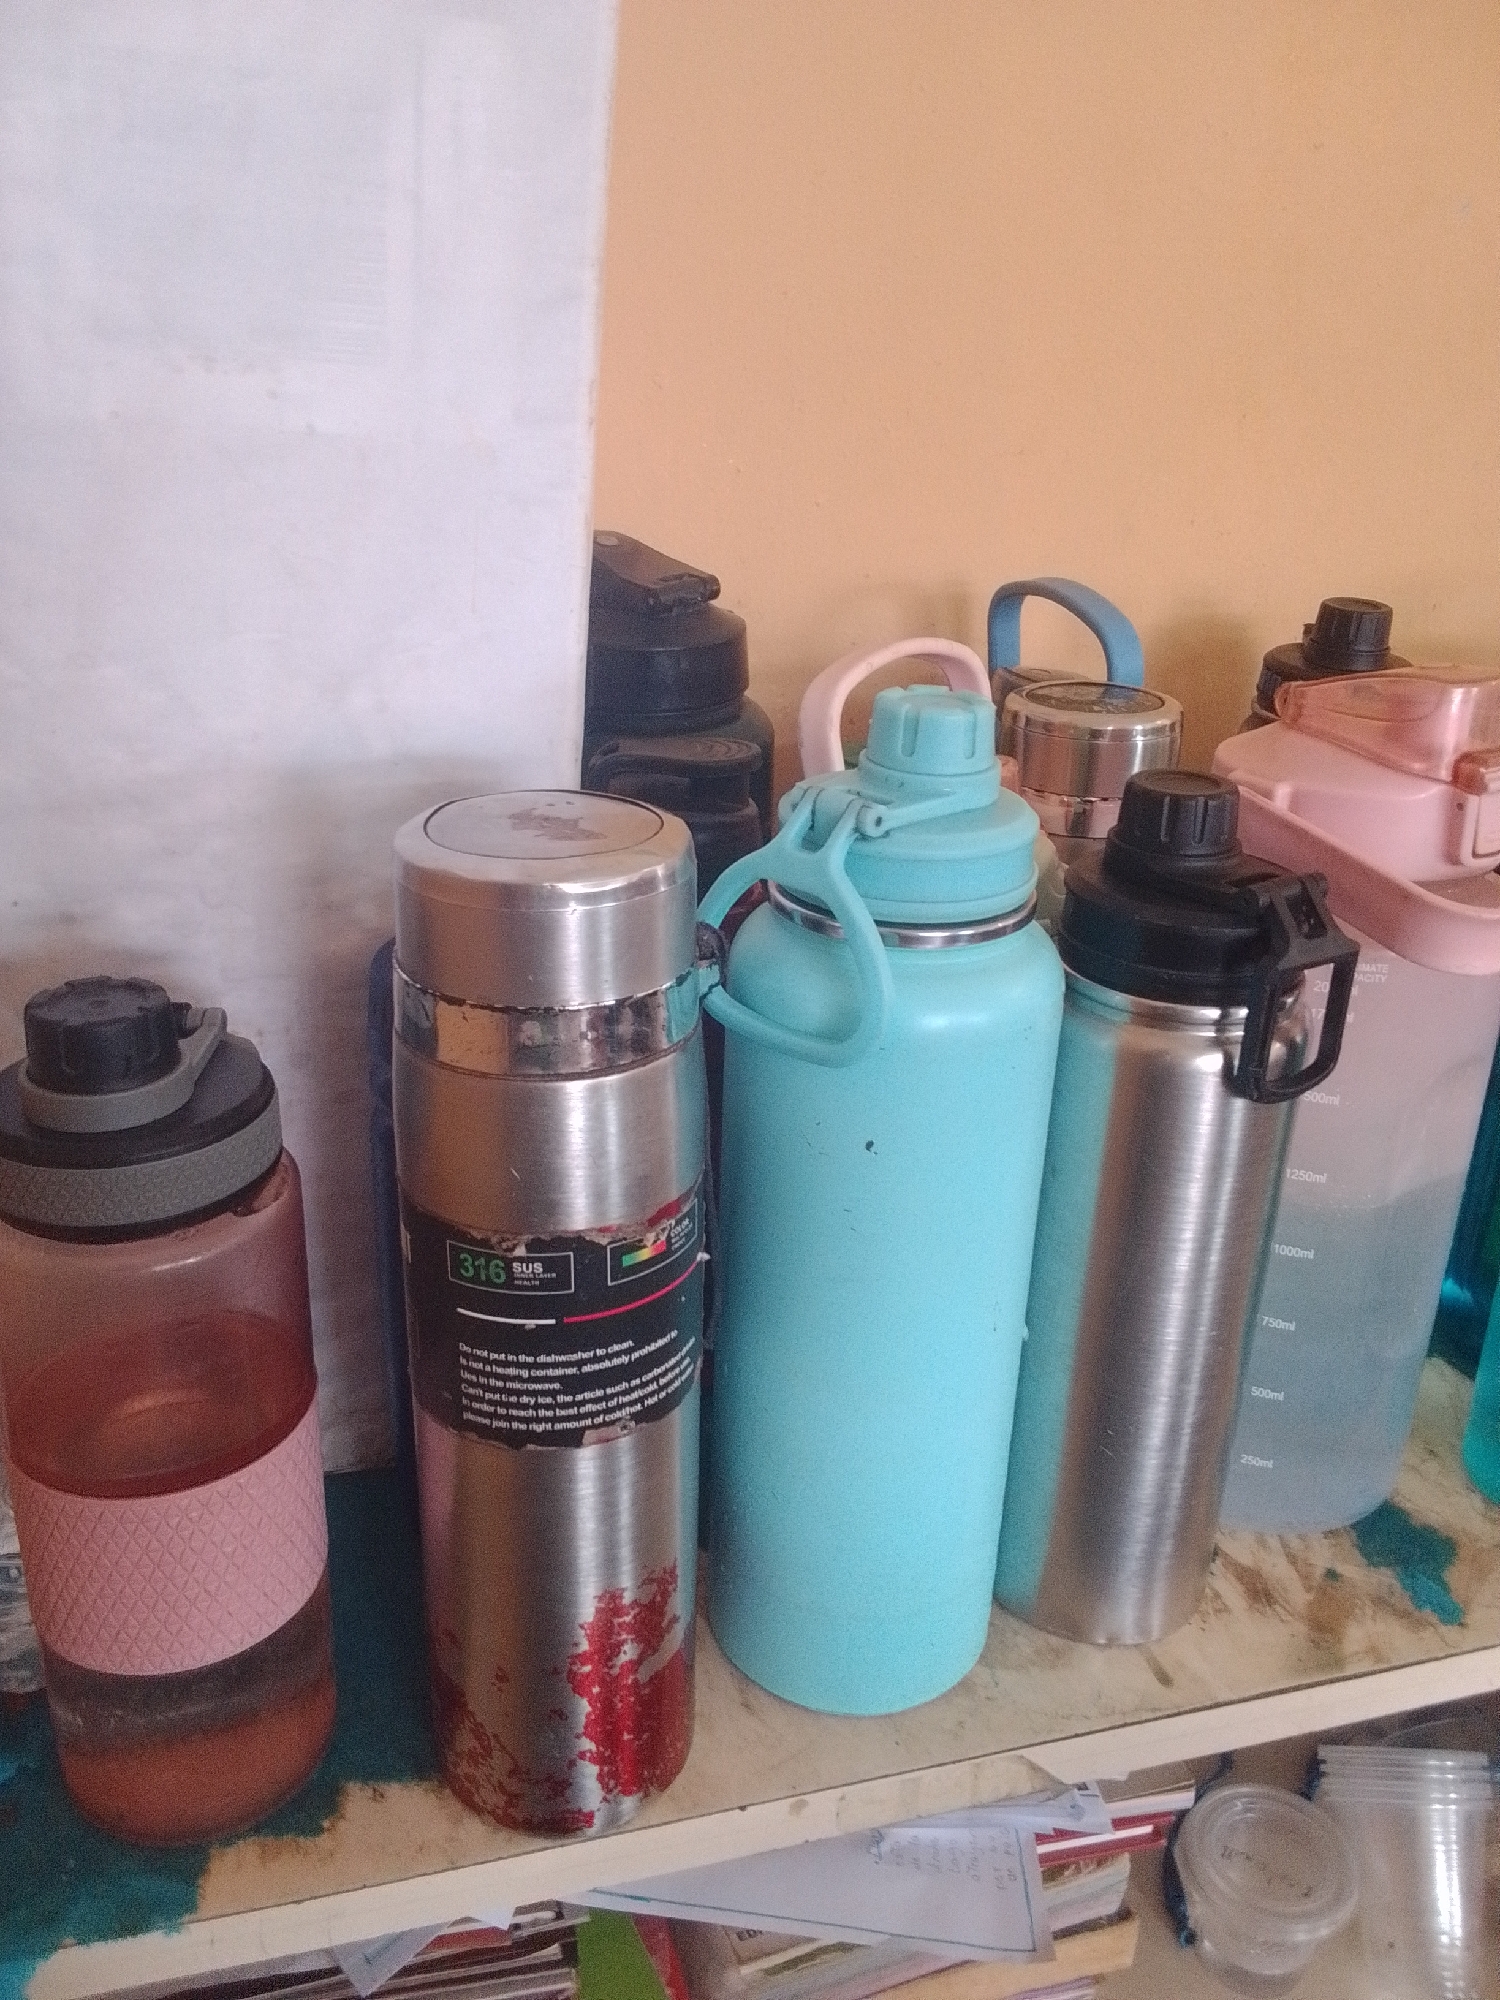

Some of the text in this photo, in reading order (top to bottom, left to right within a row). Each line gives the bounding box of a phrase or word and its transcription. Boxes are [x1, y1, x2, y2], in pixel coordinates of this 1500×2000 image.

[1303, 1090, 1340, 1106] 500ml
[1285, 1168, 1327, 1184] 1250ml
[1273, 1243, 1315, 1260] 1000ml
[459, 1253, 506, 1284] 316
[512, 1262, 543, 1274] SUS
[1262, 1315, 1296, 1332] 750ml
[459, 1342, 471, 1353] Do
[472, 1347, 489, 1358] not
[489, 1351, 507, 1361] put
[507, 1353, 517, 1362] in
[518, 1353, 535, 1363] the
[536, 1349, 595, 1363] dishwasher
[595, 1347, 607, 1357] to
[468, 1360, 484, 1371] not
[484, 1364, 492, 1372] a
[492, 1365, 529, 1378] heating
[580, 1354, 630, 1374] absolutely
[478, 1376, 489, 1385] in
[489, 1378, 505, 1388] the
[505, 1381, 563, 1391] microwave.
[484, 1391, 501, 1401] put
[519, 1394, 537, 1406] dry
[556, 1394, 574, 1403] the
[573, 1387, 605, 1402] article
[604, 1381, 630, 1396] such
[630, 1378, 641, 1388] as
[1250, 1386, 1285, 1401] 500ml
[471, 1402, 496, 1414] order
[497, 1405, 508, 1415] to
[508, 1408, 537, 1418] reach
[538, 1408, 555, 1418] the
[555, 1405, 579, 1417] best
[579, 1400, 607, 1415] effect
[607, 1397, 619, 1409] of
[491, 1418, 511, 1429] join
[511, 1420, 528, 1431] the
[528, 1421, 553, 1434] right
[553, 1417, 593, 1431] amount
[593, 1414, 605, 1426] of
[1240, 1454, 1274, 1469] 250ml
